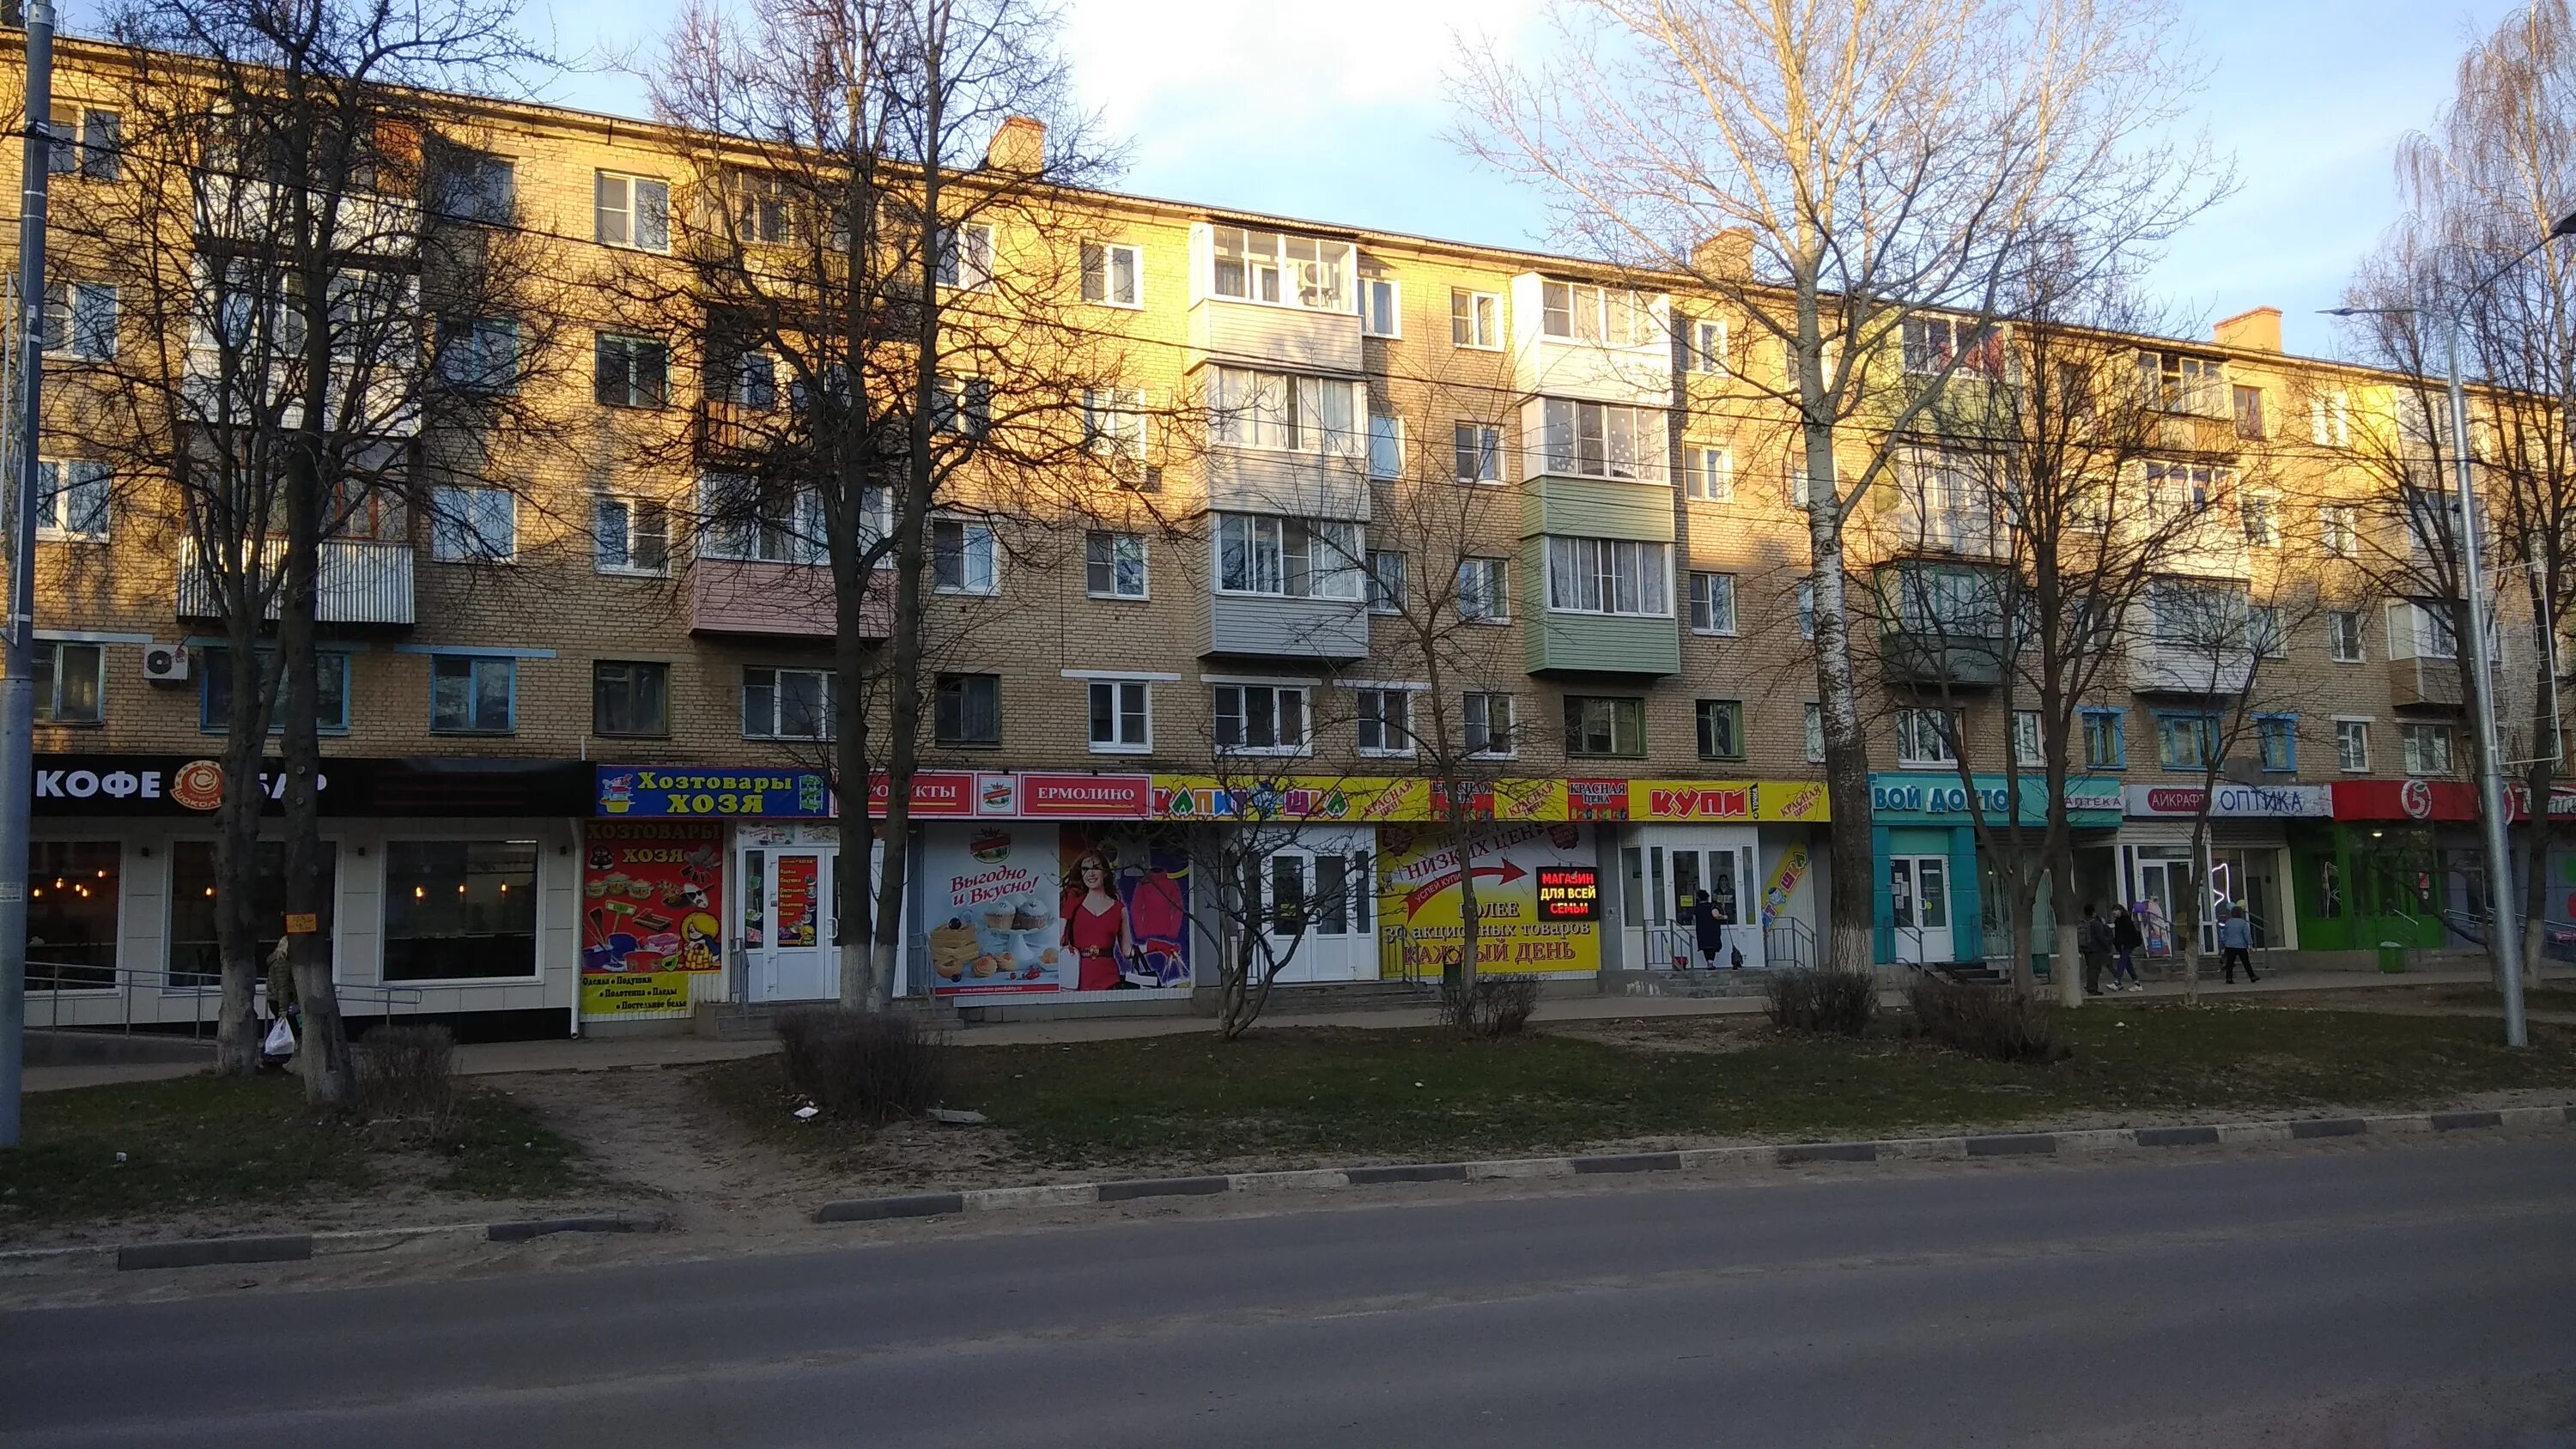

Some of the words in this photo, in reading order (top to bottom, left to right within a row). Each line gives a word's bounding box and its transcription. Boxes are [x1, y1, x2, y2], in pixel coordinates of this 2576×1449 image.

[36, 769, 161, 798] КОФЕ
[637, 772, 792, 793] Хозтовары
[1569, 781, 1627, 795] КРАСНАЯ
[1037, 786, 1134, 800] ЕРМОЛИНО
[1583, 793, 1612, 805] ЦЕНА
[1926, 787, 2022, 814] ДОТО
[2065, 797, 2122, 806] АПТЕКА
[2221, 790, 2303, 811] ОПТИКА
[666, 794, 764, 814] ХОЗЯ
[586, 824, 720, 840] ХОЗТОВАРЫ
[622, 848, 684, 863] ХОЗЯ
[951, 865, 1027, 893] Выгодно
[1542, 873, 1595, 884] МАГАЗИН
[953, 894, 963, 906] и
[969, 876, 1039, 905] Вкусно!
[1540, 888, 1564, 900] ДЛЯ
[1568, 885, 1596, 899] ВСЕЙ
[1550, 902, 1589, 914] СЕМЬИ
[1413, 925, 1516, 943] акционых
[1521, 920, 1590, 940] товаров
[1515, 942, 1576, 965] ДЕНЬ
